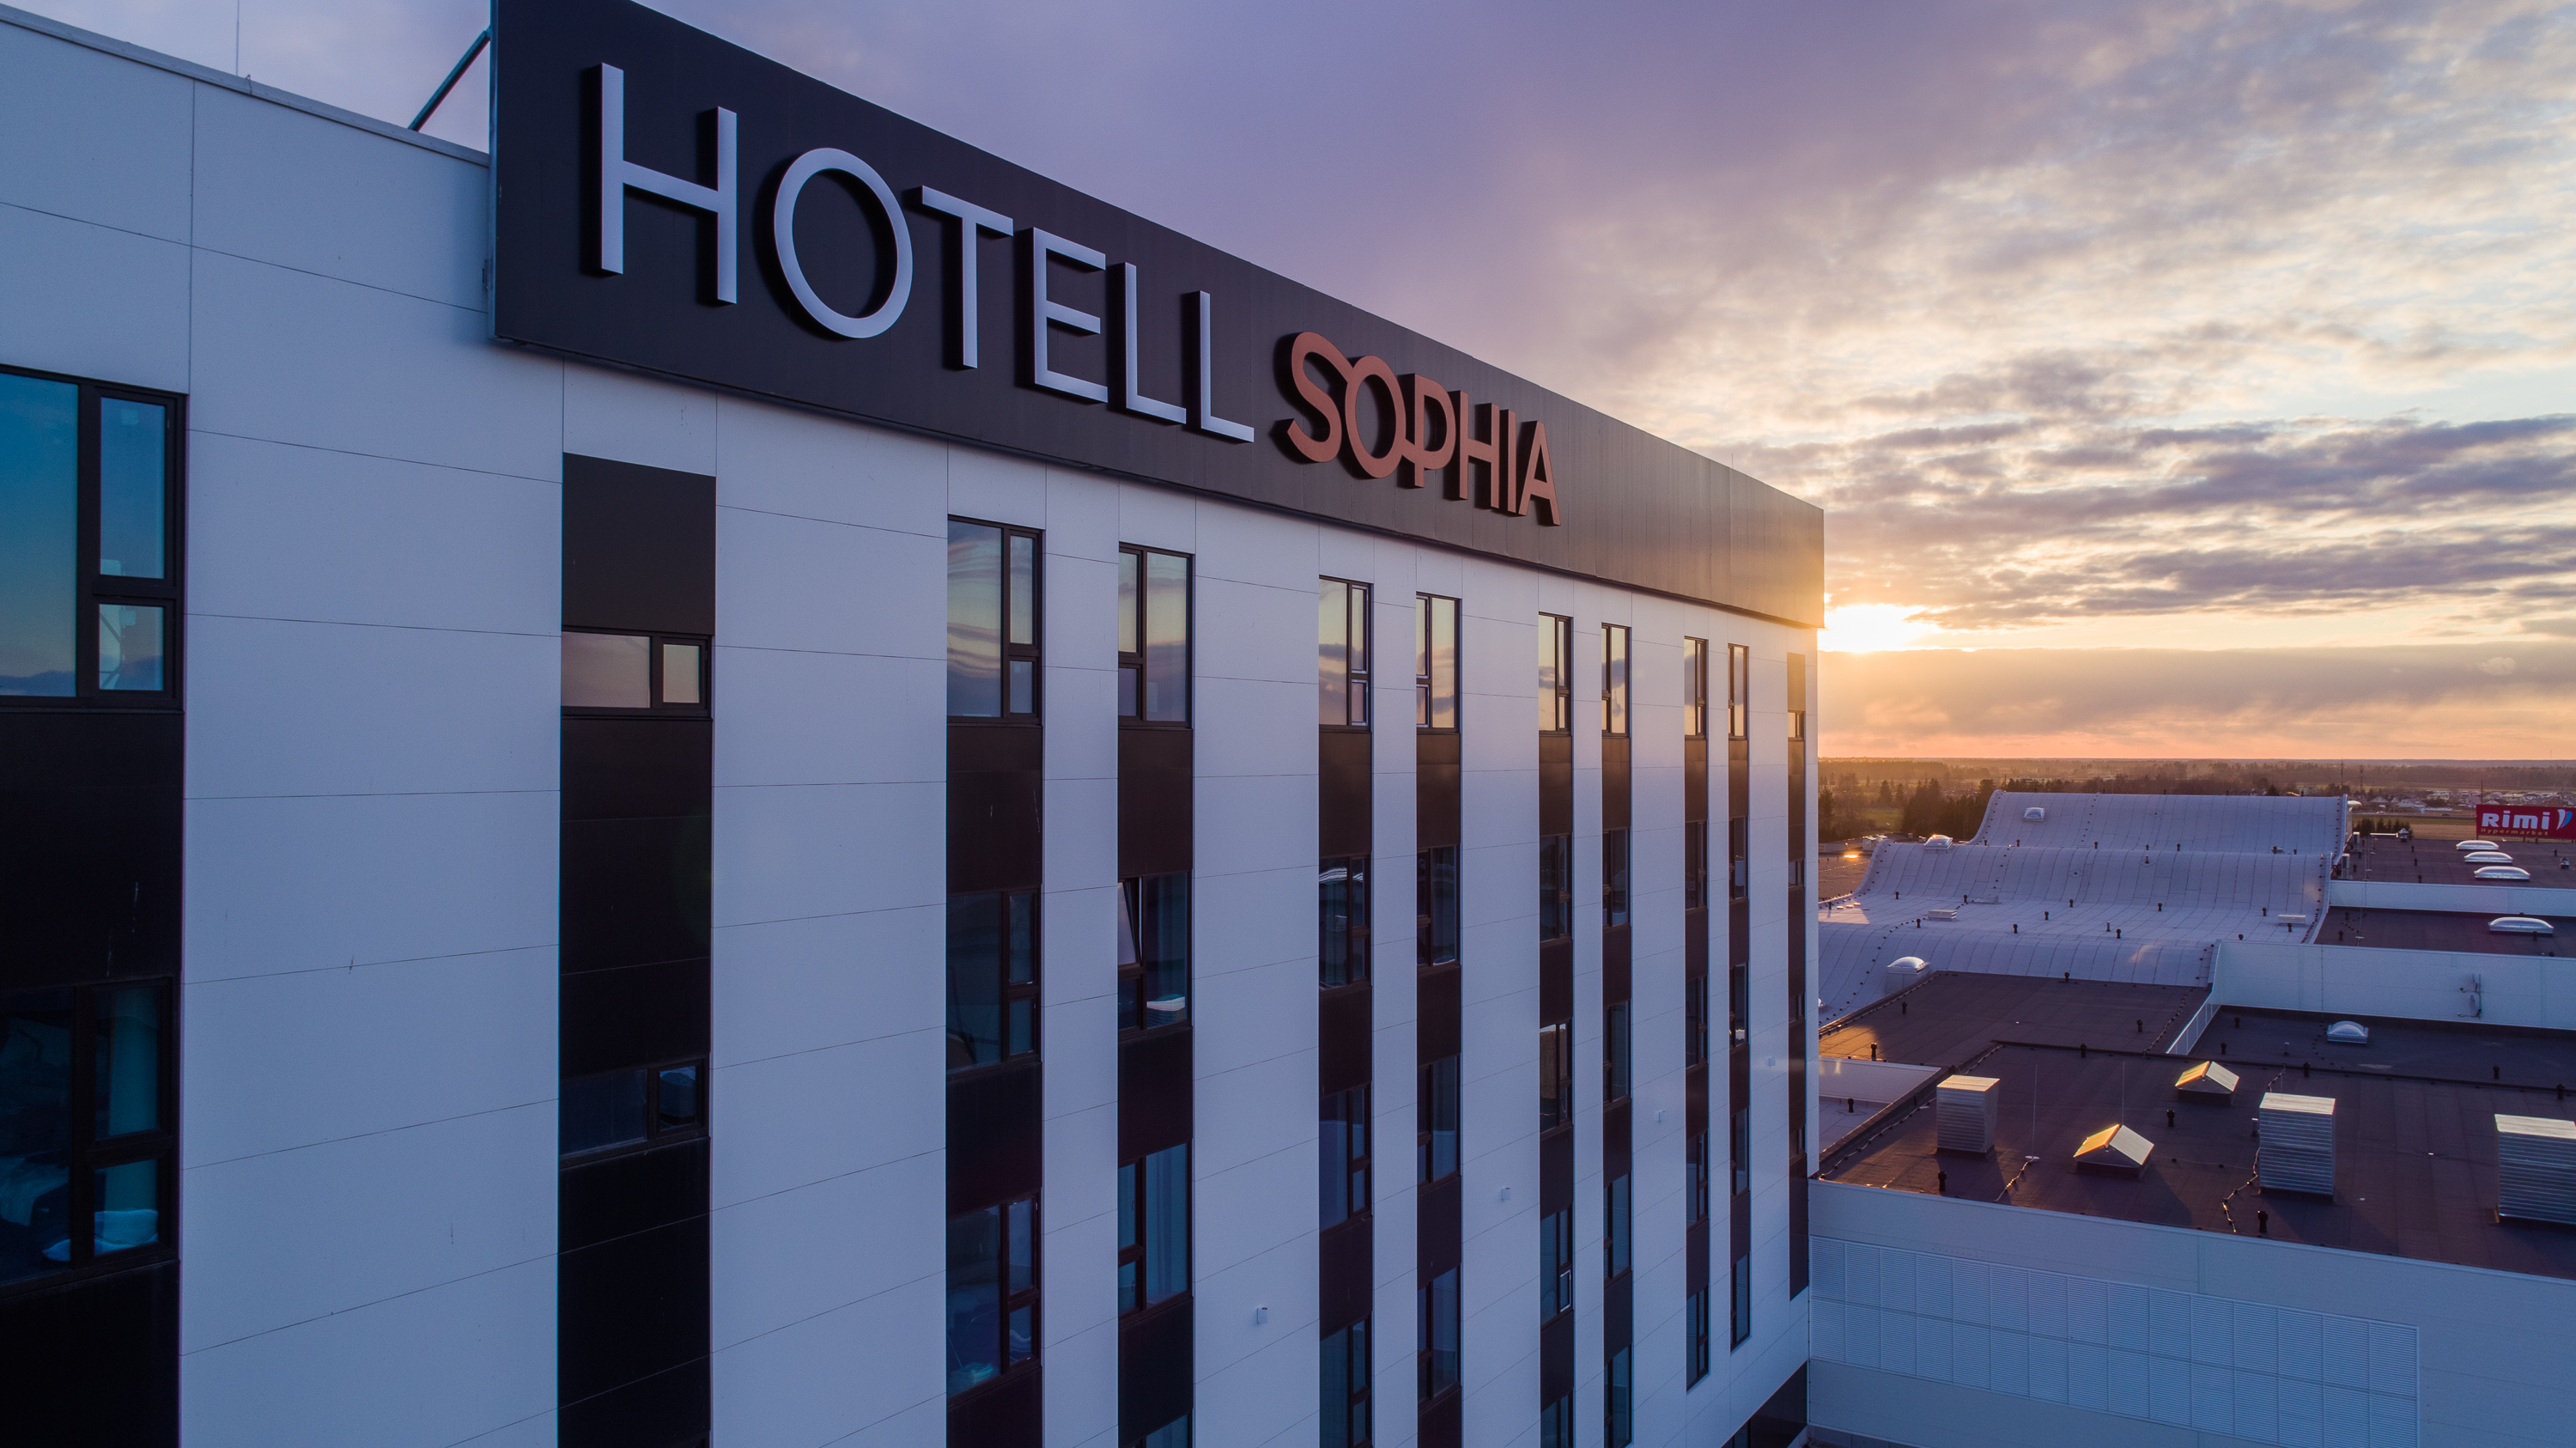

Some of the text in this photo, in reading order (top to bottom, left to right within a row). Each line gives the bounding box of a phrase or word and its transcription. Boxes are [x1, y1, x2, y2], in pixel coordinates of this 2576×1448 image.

[598, 63, 1560, 526] HOTELL SOPHIA
[2482, 810, 2550, 830] Rimi
